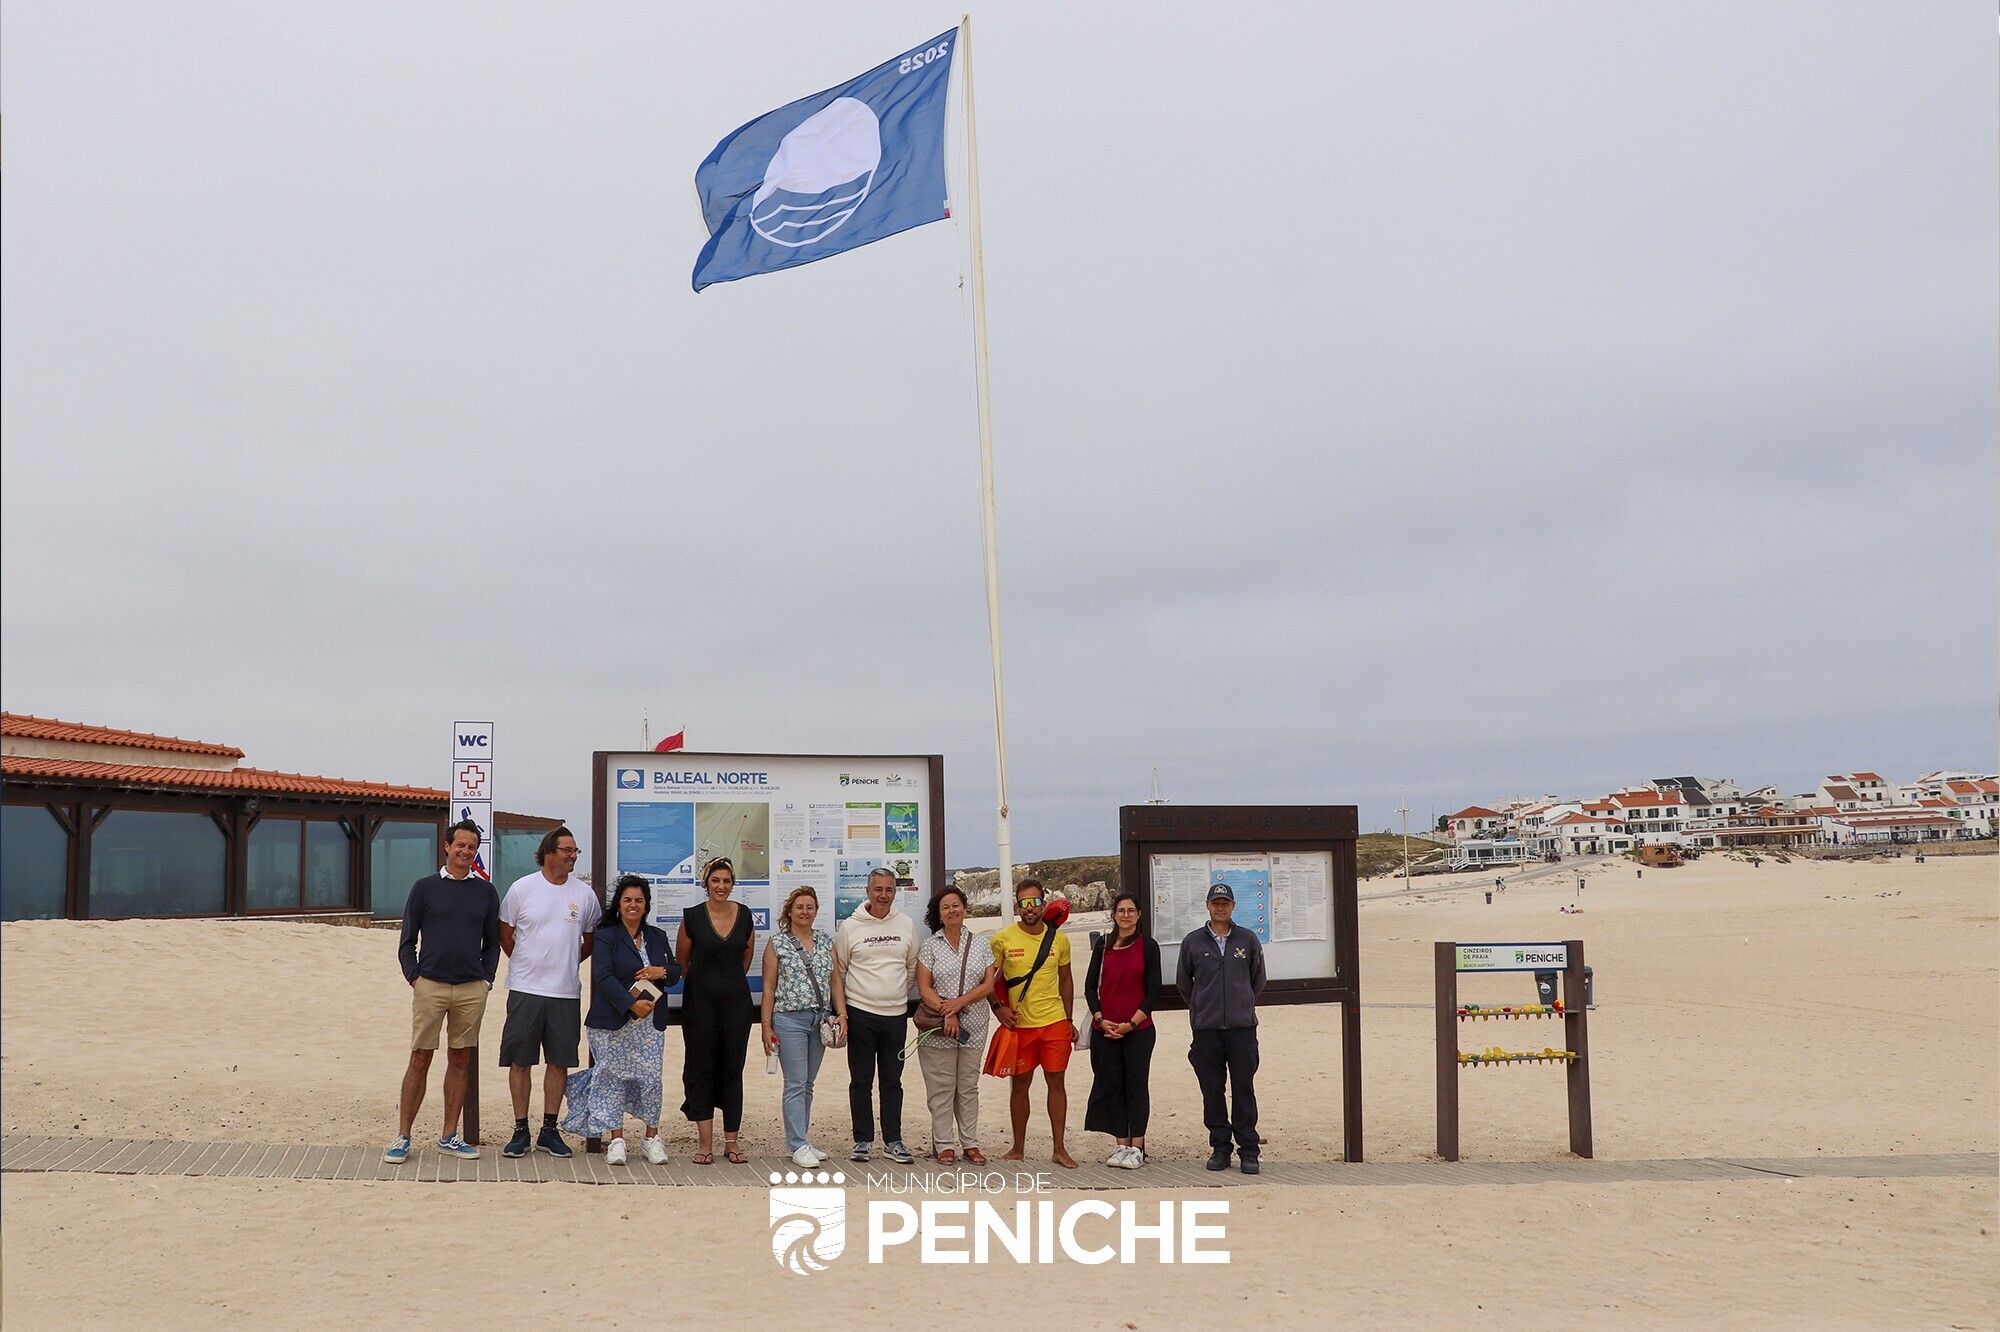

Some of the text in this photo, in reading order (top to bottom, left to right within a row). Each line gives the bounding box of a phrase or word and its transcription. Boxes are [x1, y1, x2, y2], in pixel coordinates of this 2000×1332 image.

[459, 735, 487, 747] WC
[654, 772, 767, 784] BALEAL NORTE
[1525, 953, 1564, 963] PENICHE
